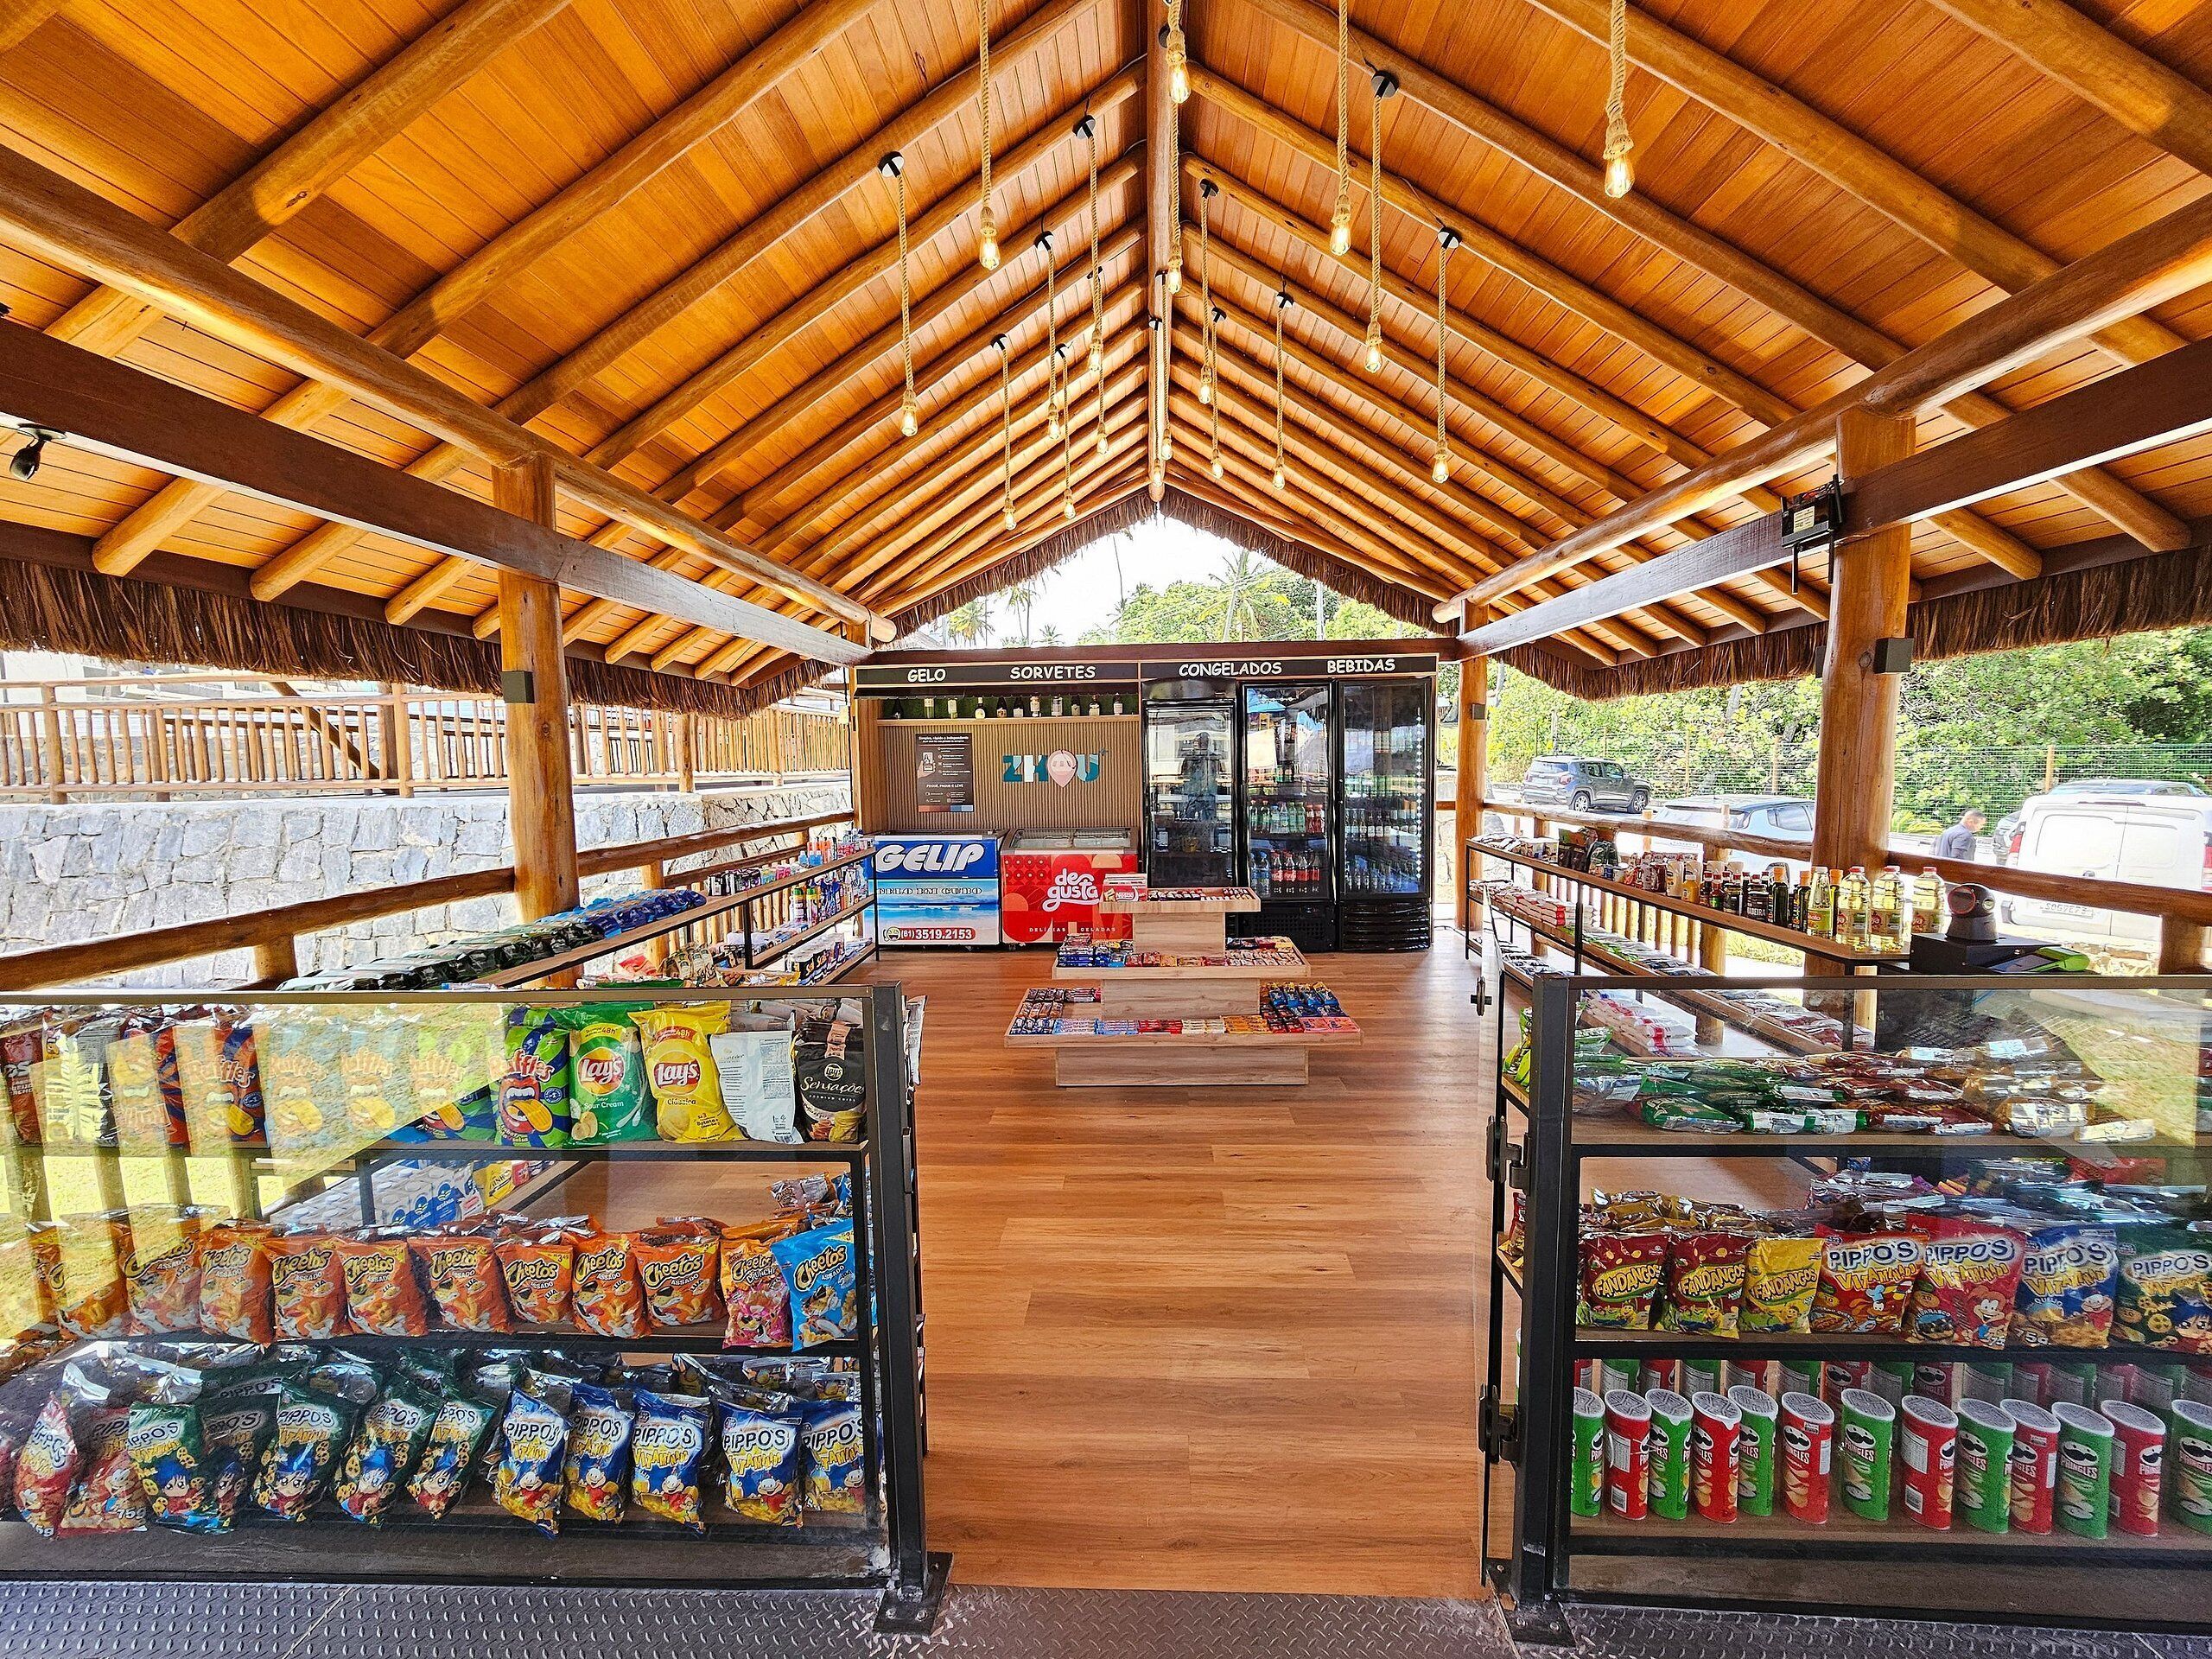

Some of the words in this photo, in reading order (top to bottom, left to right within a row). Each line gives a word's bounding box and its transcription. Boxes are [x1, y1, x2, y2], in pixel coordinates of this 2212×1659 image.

[907, 668, 946, 683] GELO
[1009, 665, 1096, 680] SORVETES
[1179, 662, 1282, 677] CONGELADOS
[1327, 658, 1395, 674] BEBIDAS
[875, 844, 984, 872] GELIP
[900, 929, 914, 939] (81)
[916, 929, 972, 939] 3519.2153
[186, 1053, 255, 1088] Ruffles
[581, 1053, 622, 1085] Lay's
[658, 1062, 699, 1086] Lay's
[574, 1246, 626, 1282] Cheetos
[1828, 1241, 1916, 1269] PIPPO'S
[1924, 1238, 2013, 1267] PIPPO'S
[2023, 1242, 2112, 1275] PIPPO'S
[2133, 1254, 2209, 1276] PIPPO'S
[272, 1247, 334, 1287] Cheetos
[342, 1251, 395, 1285] Cheetos
[505, 1258, 559, 1289] Cheetos
[596, 1272, 620, 1281] ASSADO
[644, 1251, 705, 1290] Cheetos
[671, 1273, 700, 1287] ASSADO
[793, 1244, 848, 1292] Cheetos
[821, 1264, 845, 1281] ASSADO
[1594, 1264, 1661, 1296] FANDANGOS
[1681, 1265, 1745, 1297] FANDANGOS
[1753, 1268, 1817, 1300] FANDANGOS
[505, 1421, 560, 1447] PIPPO'S
[634, 1427, 696, 1449] PIPPO'S
[723, 1429, 788, 1452] PIPPO'S
[2061, 1456, 2098, 1480] PRINGLES
